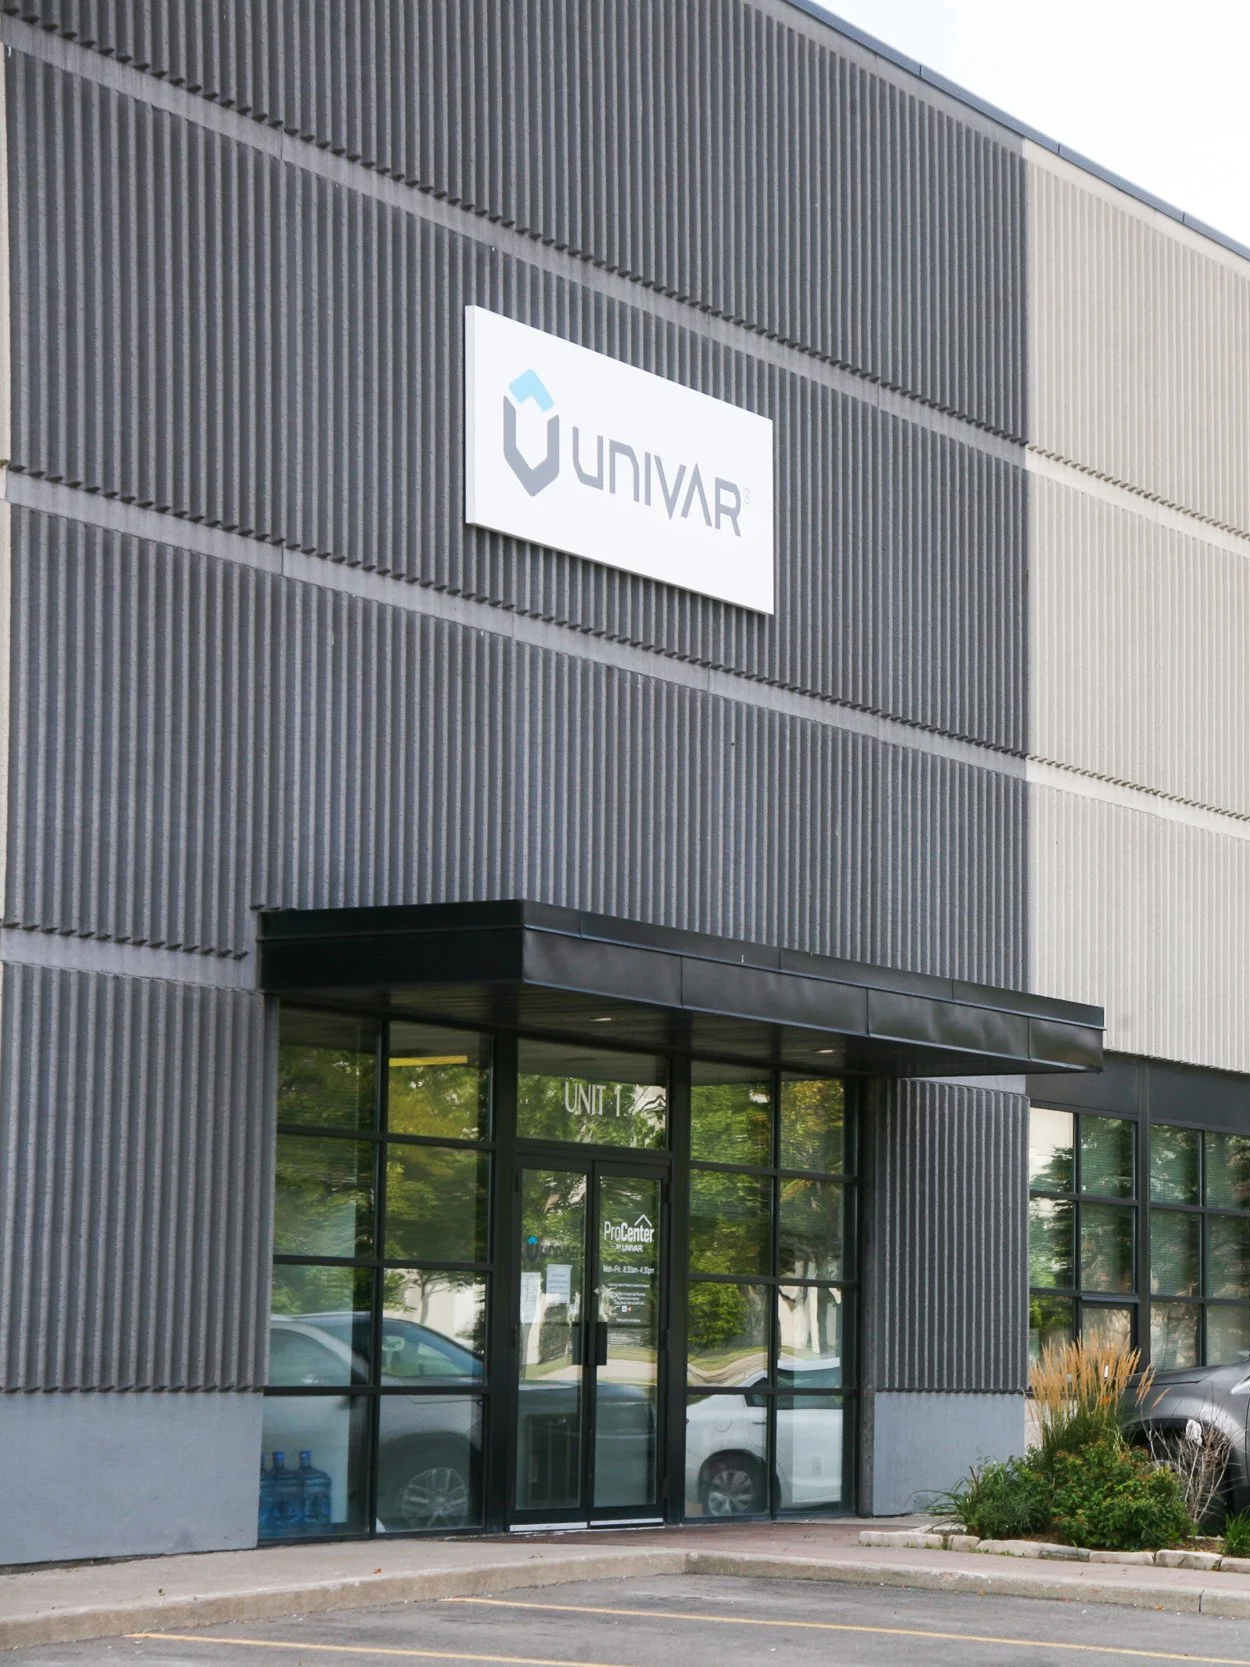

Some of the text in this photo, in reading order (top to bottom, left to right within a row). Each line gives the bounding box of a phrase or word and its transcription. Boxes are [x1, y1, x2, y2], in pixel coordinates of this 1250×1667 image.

[565, 1081, 621, 1117] UNIT 1
[604, 1221, 654, 1243] ProCenter
